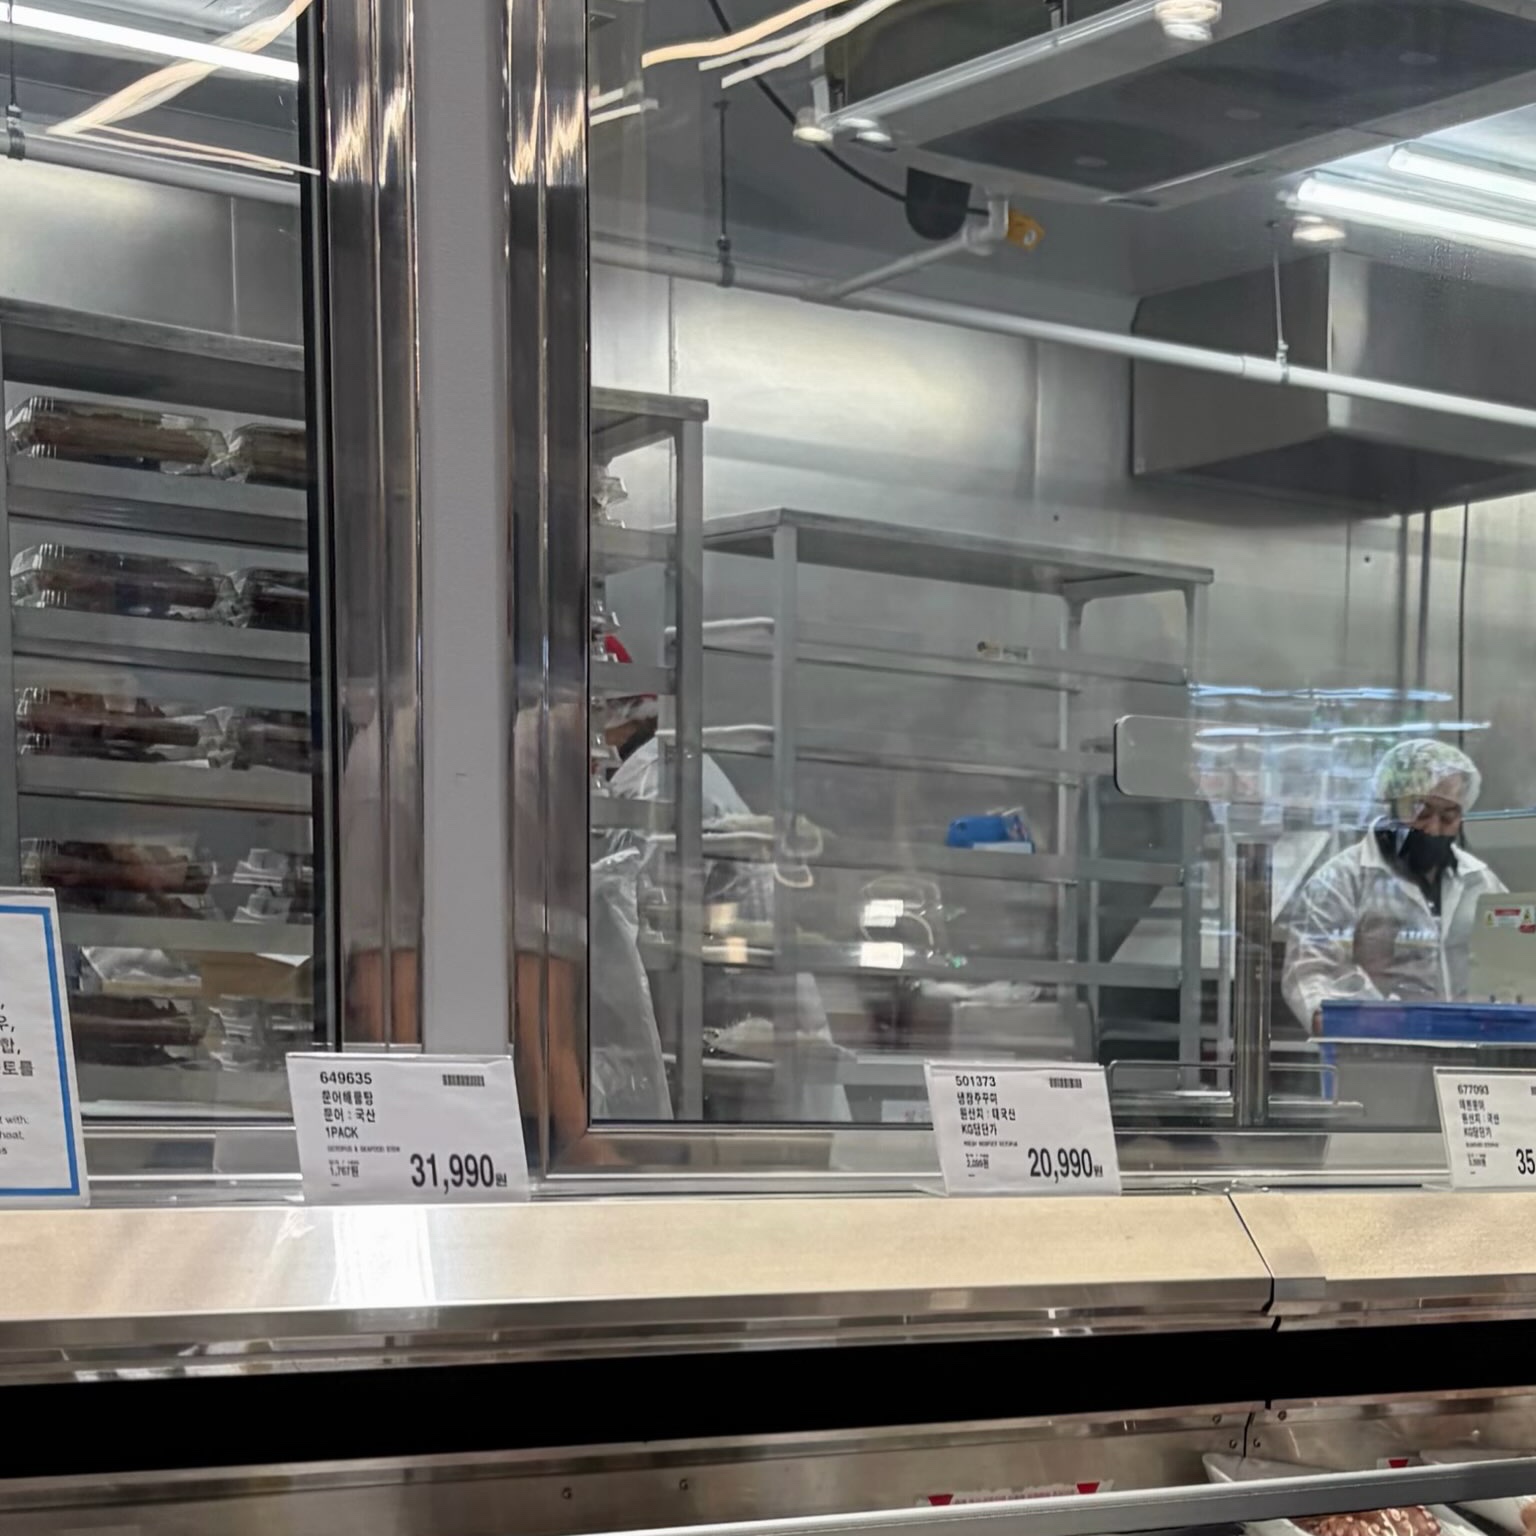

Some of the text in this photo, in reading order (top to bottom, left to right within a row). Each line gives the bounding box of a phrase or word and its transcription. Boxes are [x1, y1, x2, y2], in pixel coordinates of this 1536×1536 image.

[320, 1071, 372, 1085] 649635
[955, 1076, 996, 1087] 501373
[1457, 1085, 1489, 1095] 677093
[322, 1090, 373, 1106] 문어해물탕
[957, 1091, 998, 1105] 냉장주꾸미
[324, 1108, 345, 1123] 문어
[355, 1108, 376, 1123] 국산
[960, 1107, 984, 1121] 원산지
[325, 1126, 359, 1139] 1PACK
[961, 1123, 997, 1136] KG당단가
